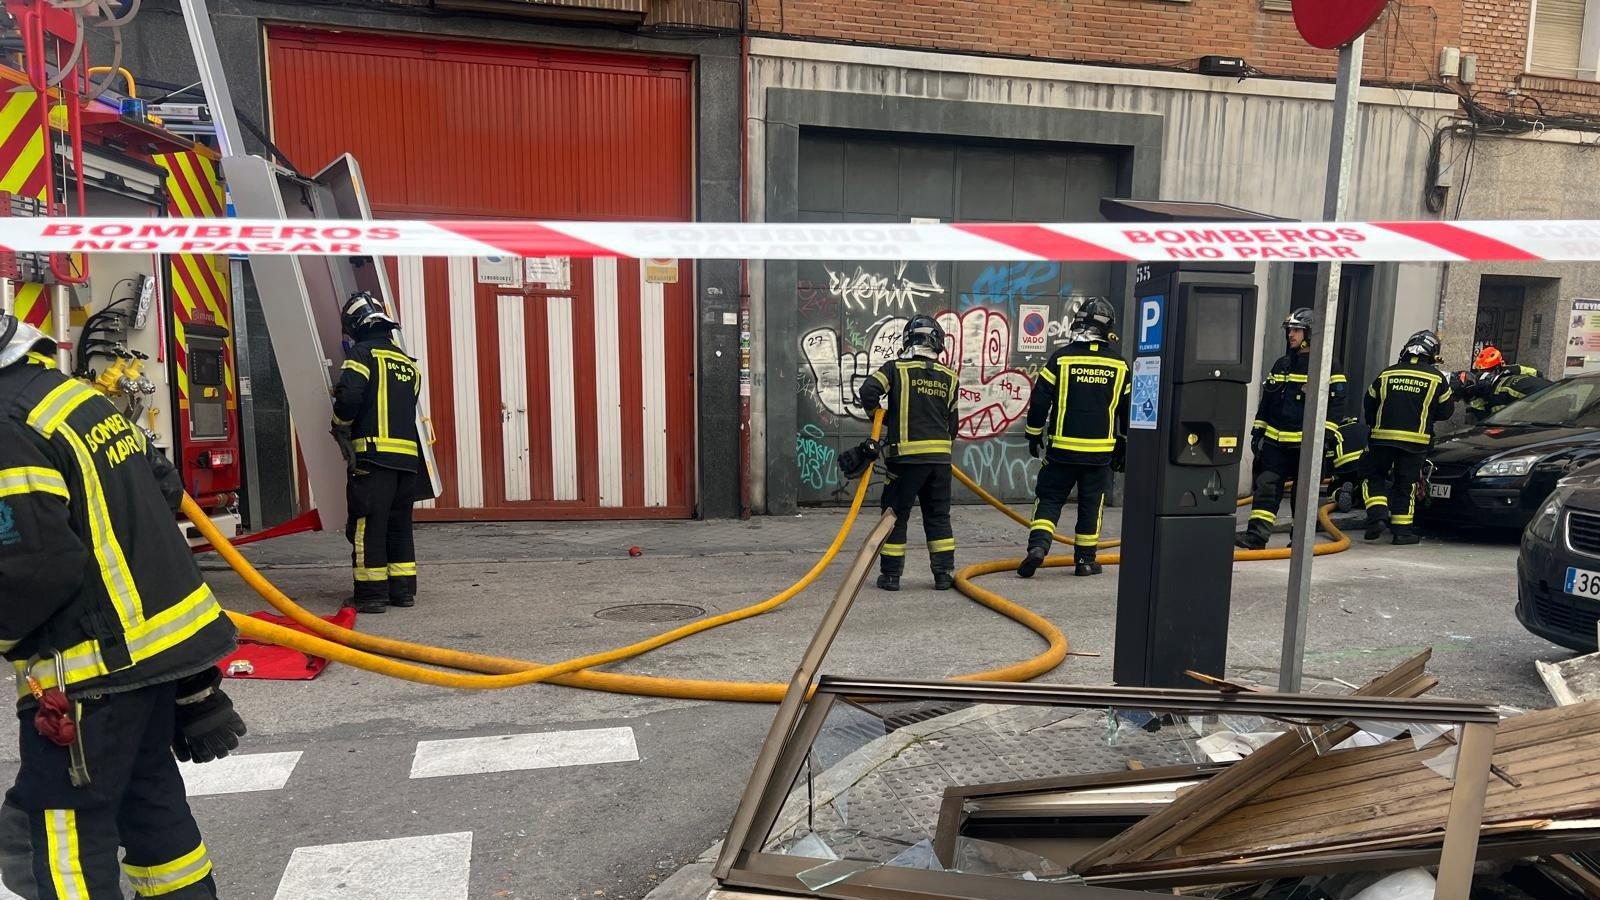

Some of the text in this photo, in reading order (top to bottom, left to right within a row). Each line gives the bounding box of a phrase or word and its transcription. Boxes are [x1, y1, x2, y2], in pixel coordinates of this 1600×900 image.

[41, 223, 401, 240] BOMBEROS
[1121, 228, 1366, 244] BOMBEROS
[71, 240, 363, 254] NO PASAR
[1164, 245, 1361, 259] NO PASAR
[1141, 300, 1160, 343] P
[1022, 336, 1045, 344] VADO
[1071, 367, 1115, 378] BOMBEROS
[1076, 375, 1108, 385] MADRID
[1389, 378, 1429, 388] BOMBEROS
[1392, 384, 1421, 394] MADRID
[1431, 484, 1449, 495] FLV
[1577, 573, 1600, 596] 36
